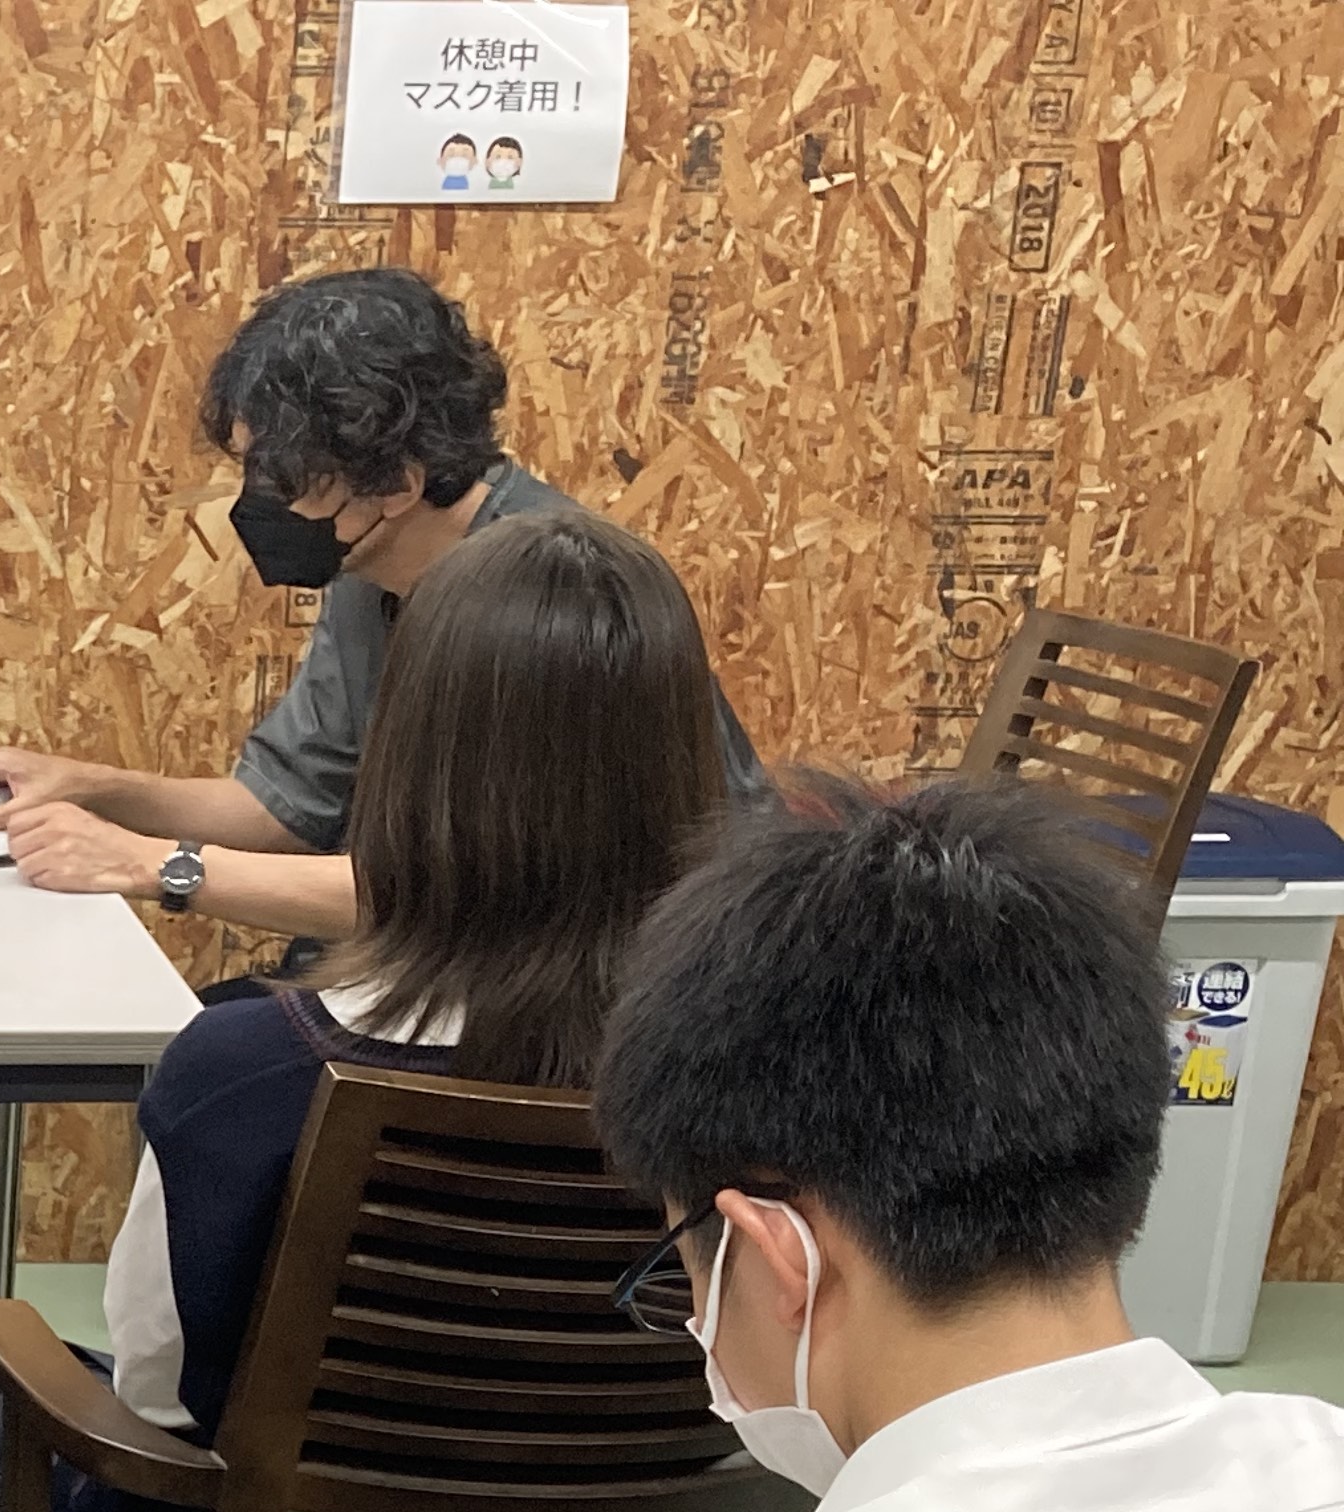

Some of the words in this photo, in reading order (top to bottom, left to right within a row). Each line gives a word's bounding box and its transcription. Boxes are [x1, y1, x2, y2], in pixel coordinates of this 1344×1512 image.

[441, 37, 540, 72] 休憩中
[1018, 183, 1055, 254] 2018
[952, 468, 1031, 490] APA
[943, 621, 981, 640] JAS
